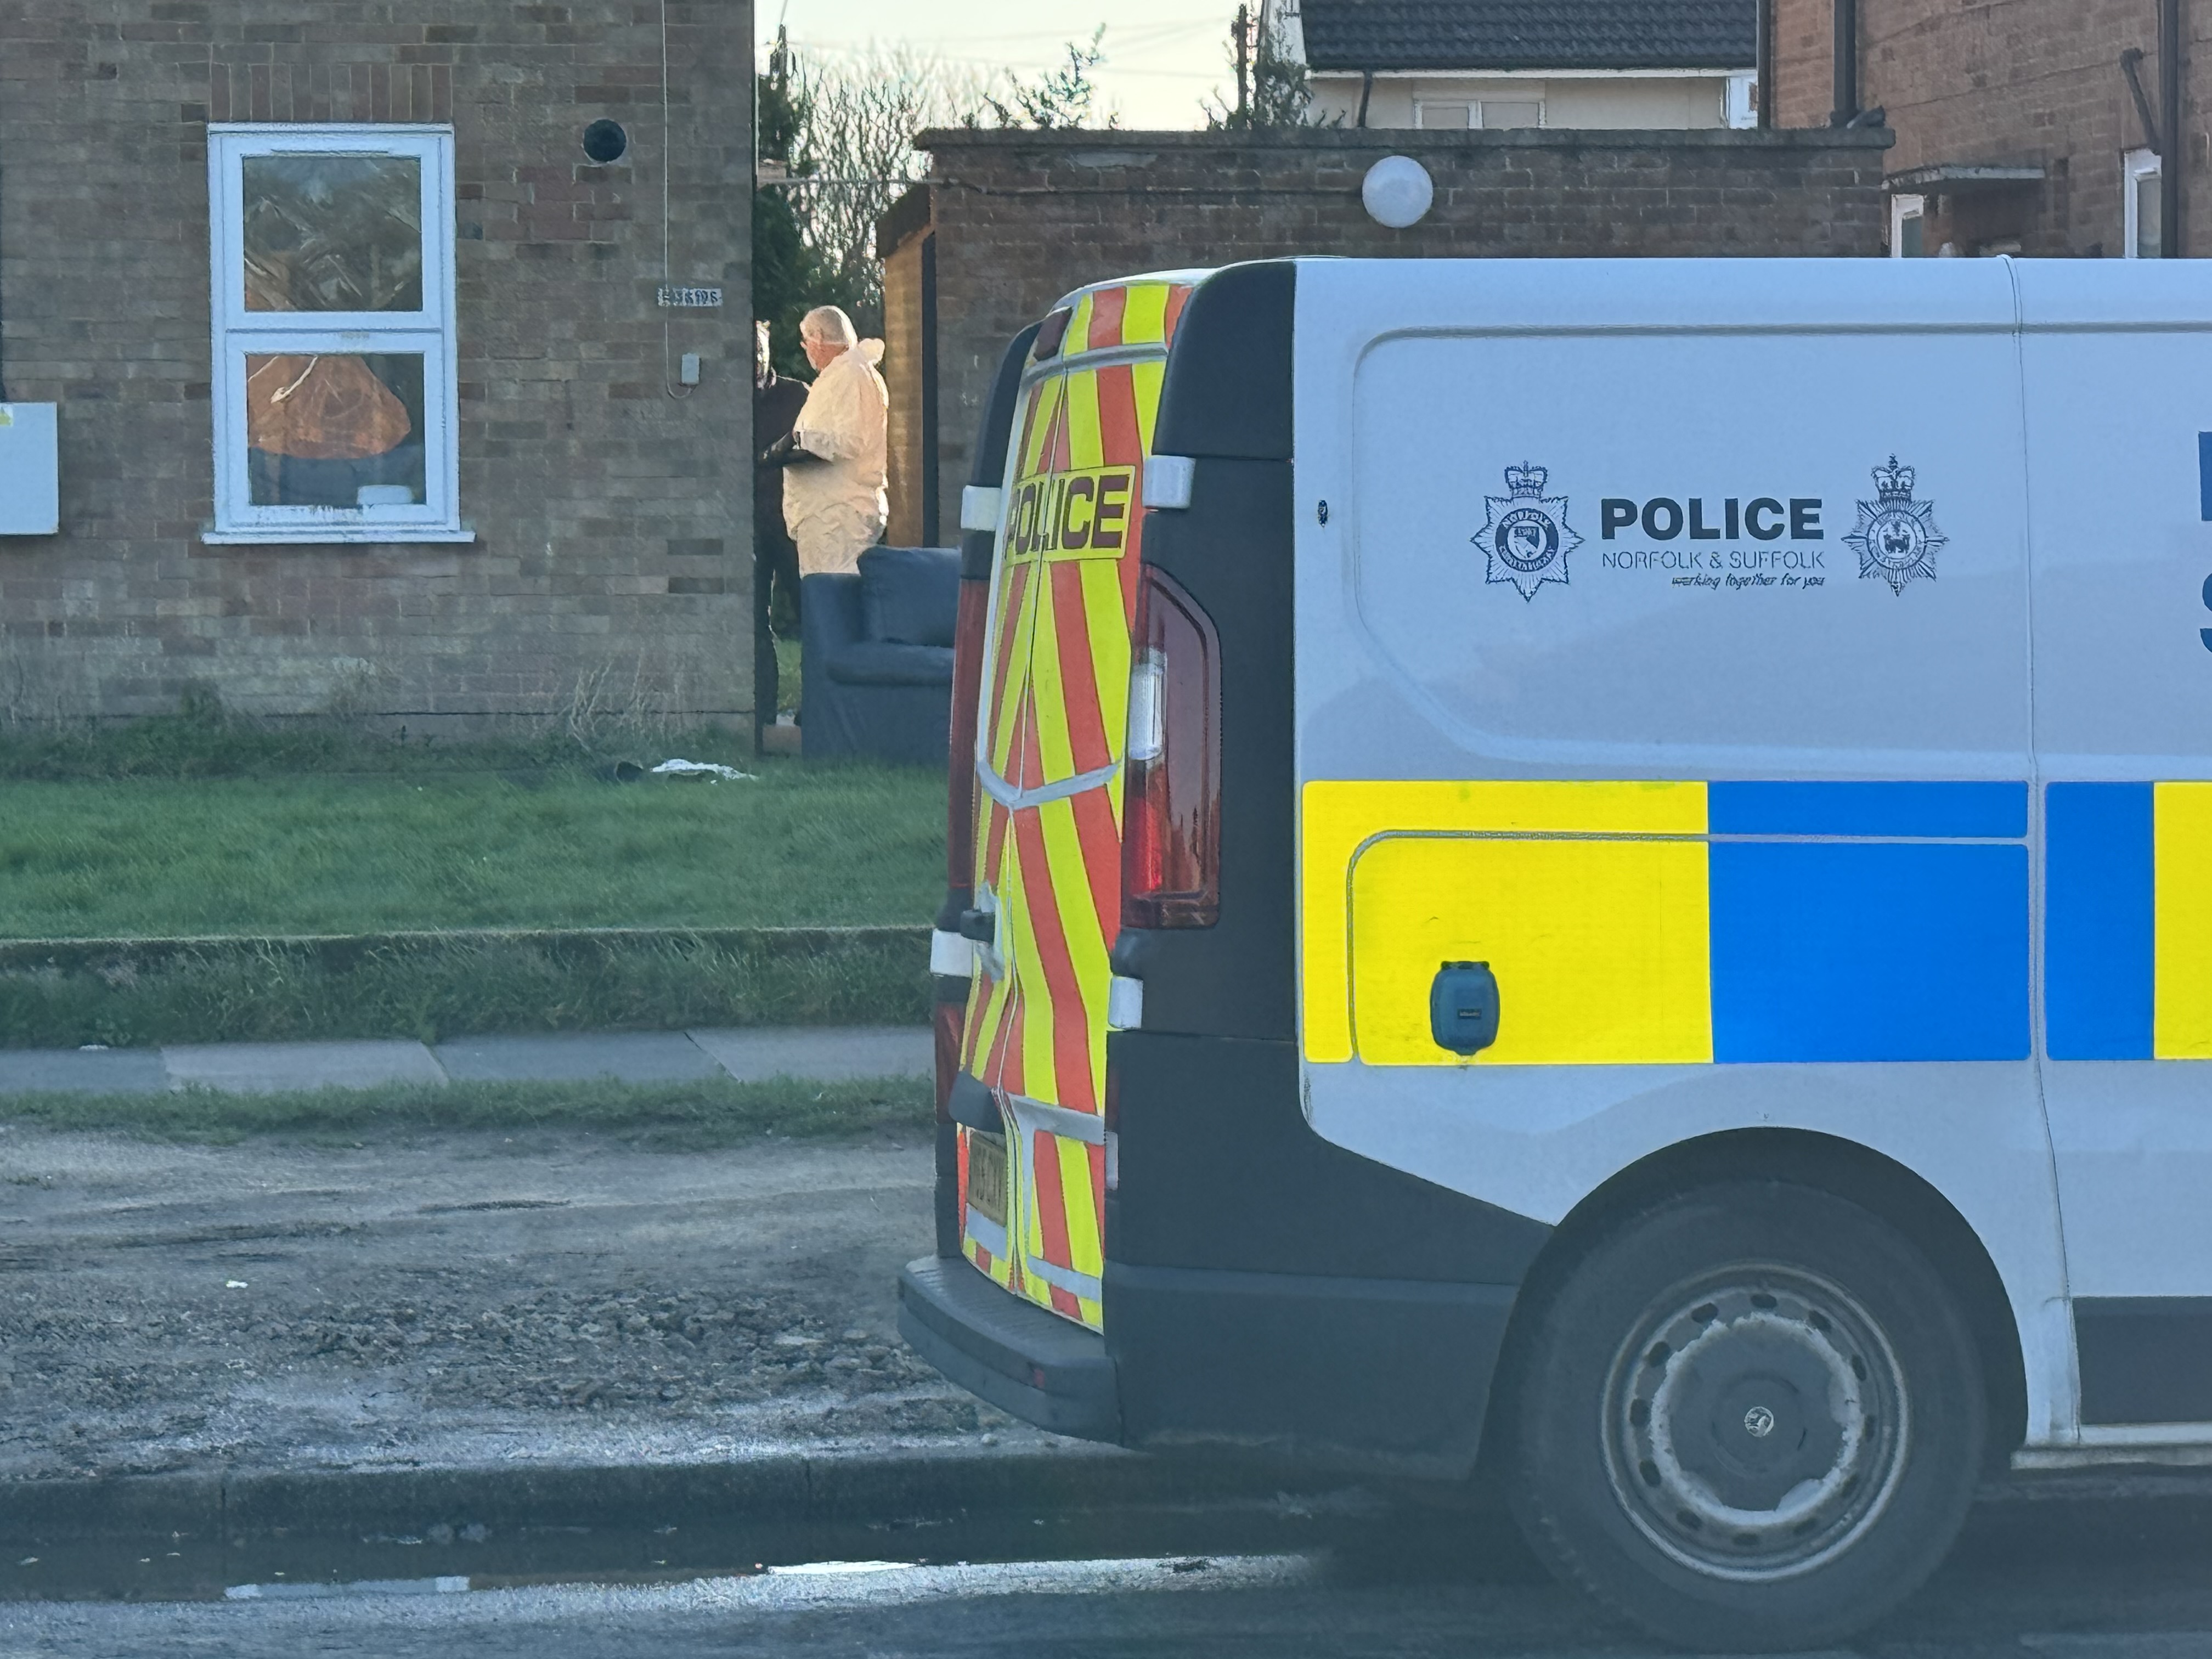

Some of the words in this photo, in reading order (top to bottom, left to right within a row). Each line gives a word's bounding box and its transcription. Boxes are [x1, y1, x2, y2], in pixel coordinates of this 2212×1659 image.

[1601, 497, 1824, 540] POLICE
[1602, 551, 1703, 569] NORFOLK
[1709, 551, 1723, 569] &
[1729, 551, 1825, 569] SUFFOLK
[1726, 573, 1777, 590] together
[1781, 573, 1801, 586] for
[1803, 577, 1826, 590] you
